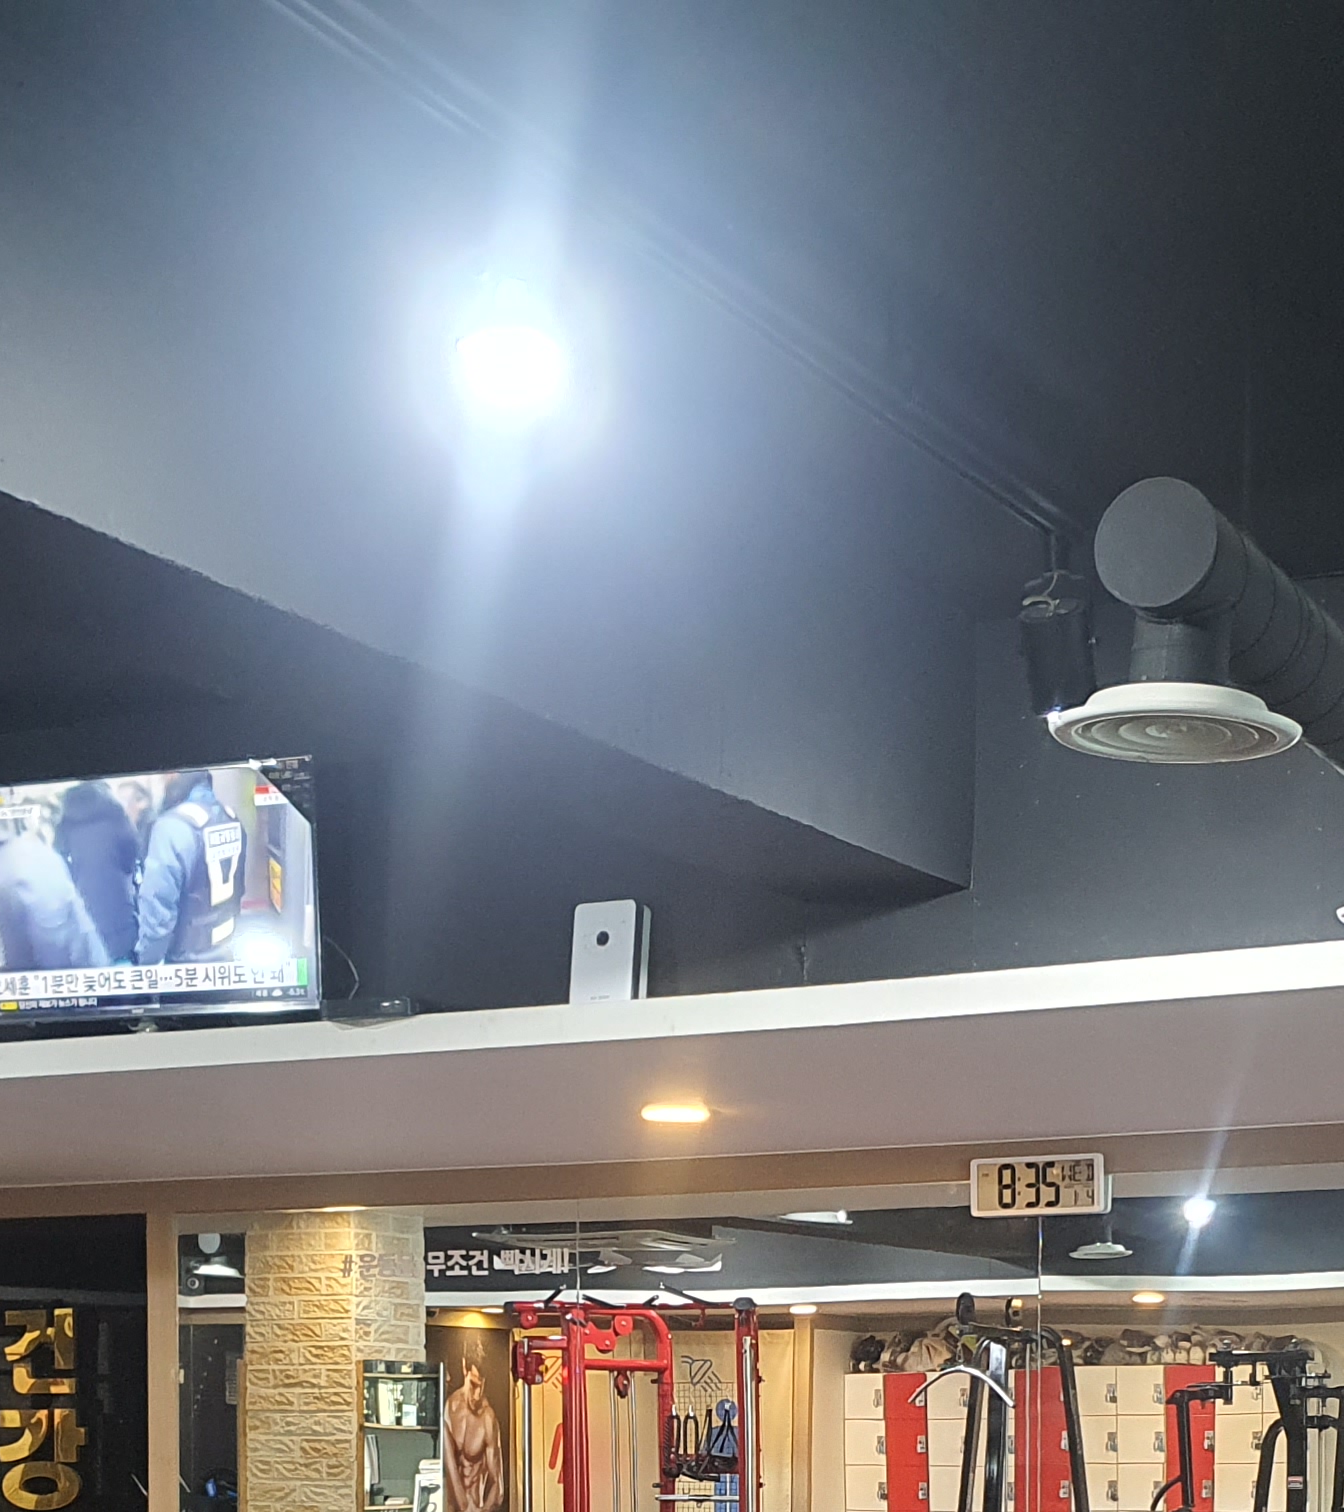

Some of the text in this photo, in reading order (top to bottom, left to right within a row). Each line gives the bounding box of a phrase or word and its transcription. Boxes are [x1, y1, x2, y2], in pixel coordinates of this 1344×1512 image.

[82, 971, 127, 992] 늦어도
[202, 965, 248, 987] 시위도
[998, 1163, 1060, 1209] 8:35
[426, 1250, 489, 1277] 무조건
